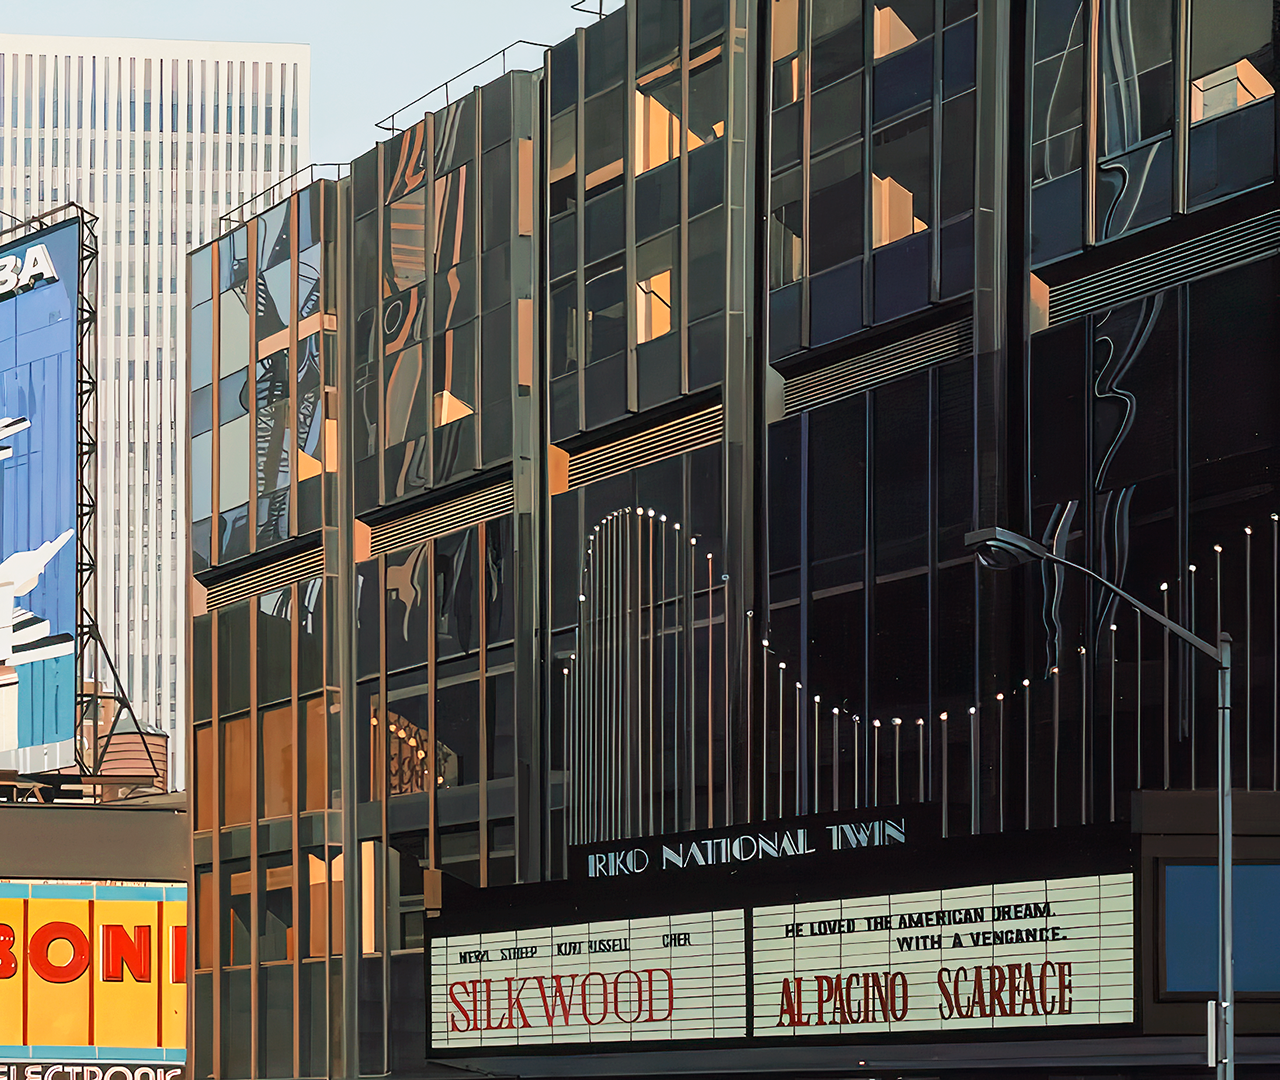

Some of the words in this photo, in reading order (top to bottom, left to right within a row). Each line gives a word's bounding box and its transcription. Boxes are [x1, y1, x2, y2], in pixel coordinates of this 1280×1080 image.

[662, 827, 816, 871] NATIONAL
[826, 817, 906, 851] TWIN
[662, 932, 692, 948] CHER
[809, 917, 857, 936] LOVED
[898, 906, 986, 930] AMERICAN
[896, 933, 942, 952] WITH
[951, 932, 964, 949] A
[448, 967, 674, 1033] SILKWOOD
[813, 970, 909, 1027] PACINO
[937, 960, 1073, 1022] SCARFACE
